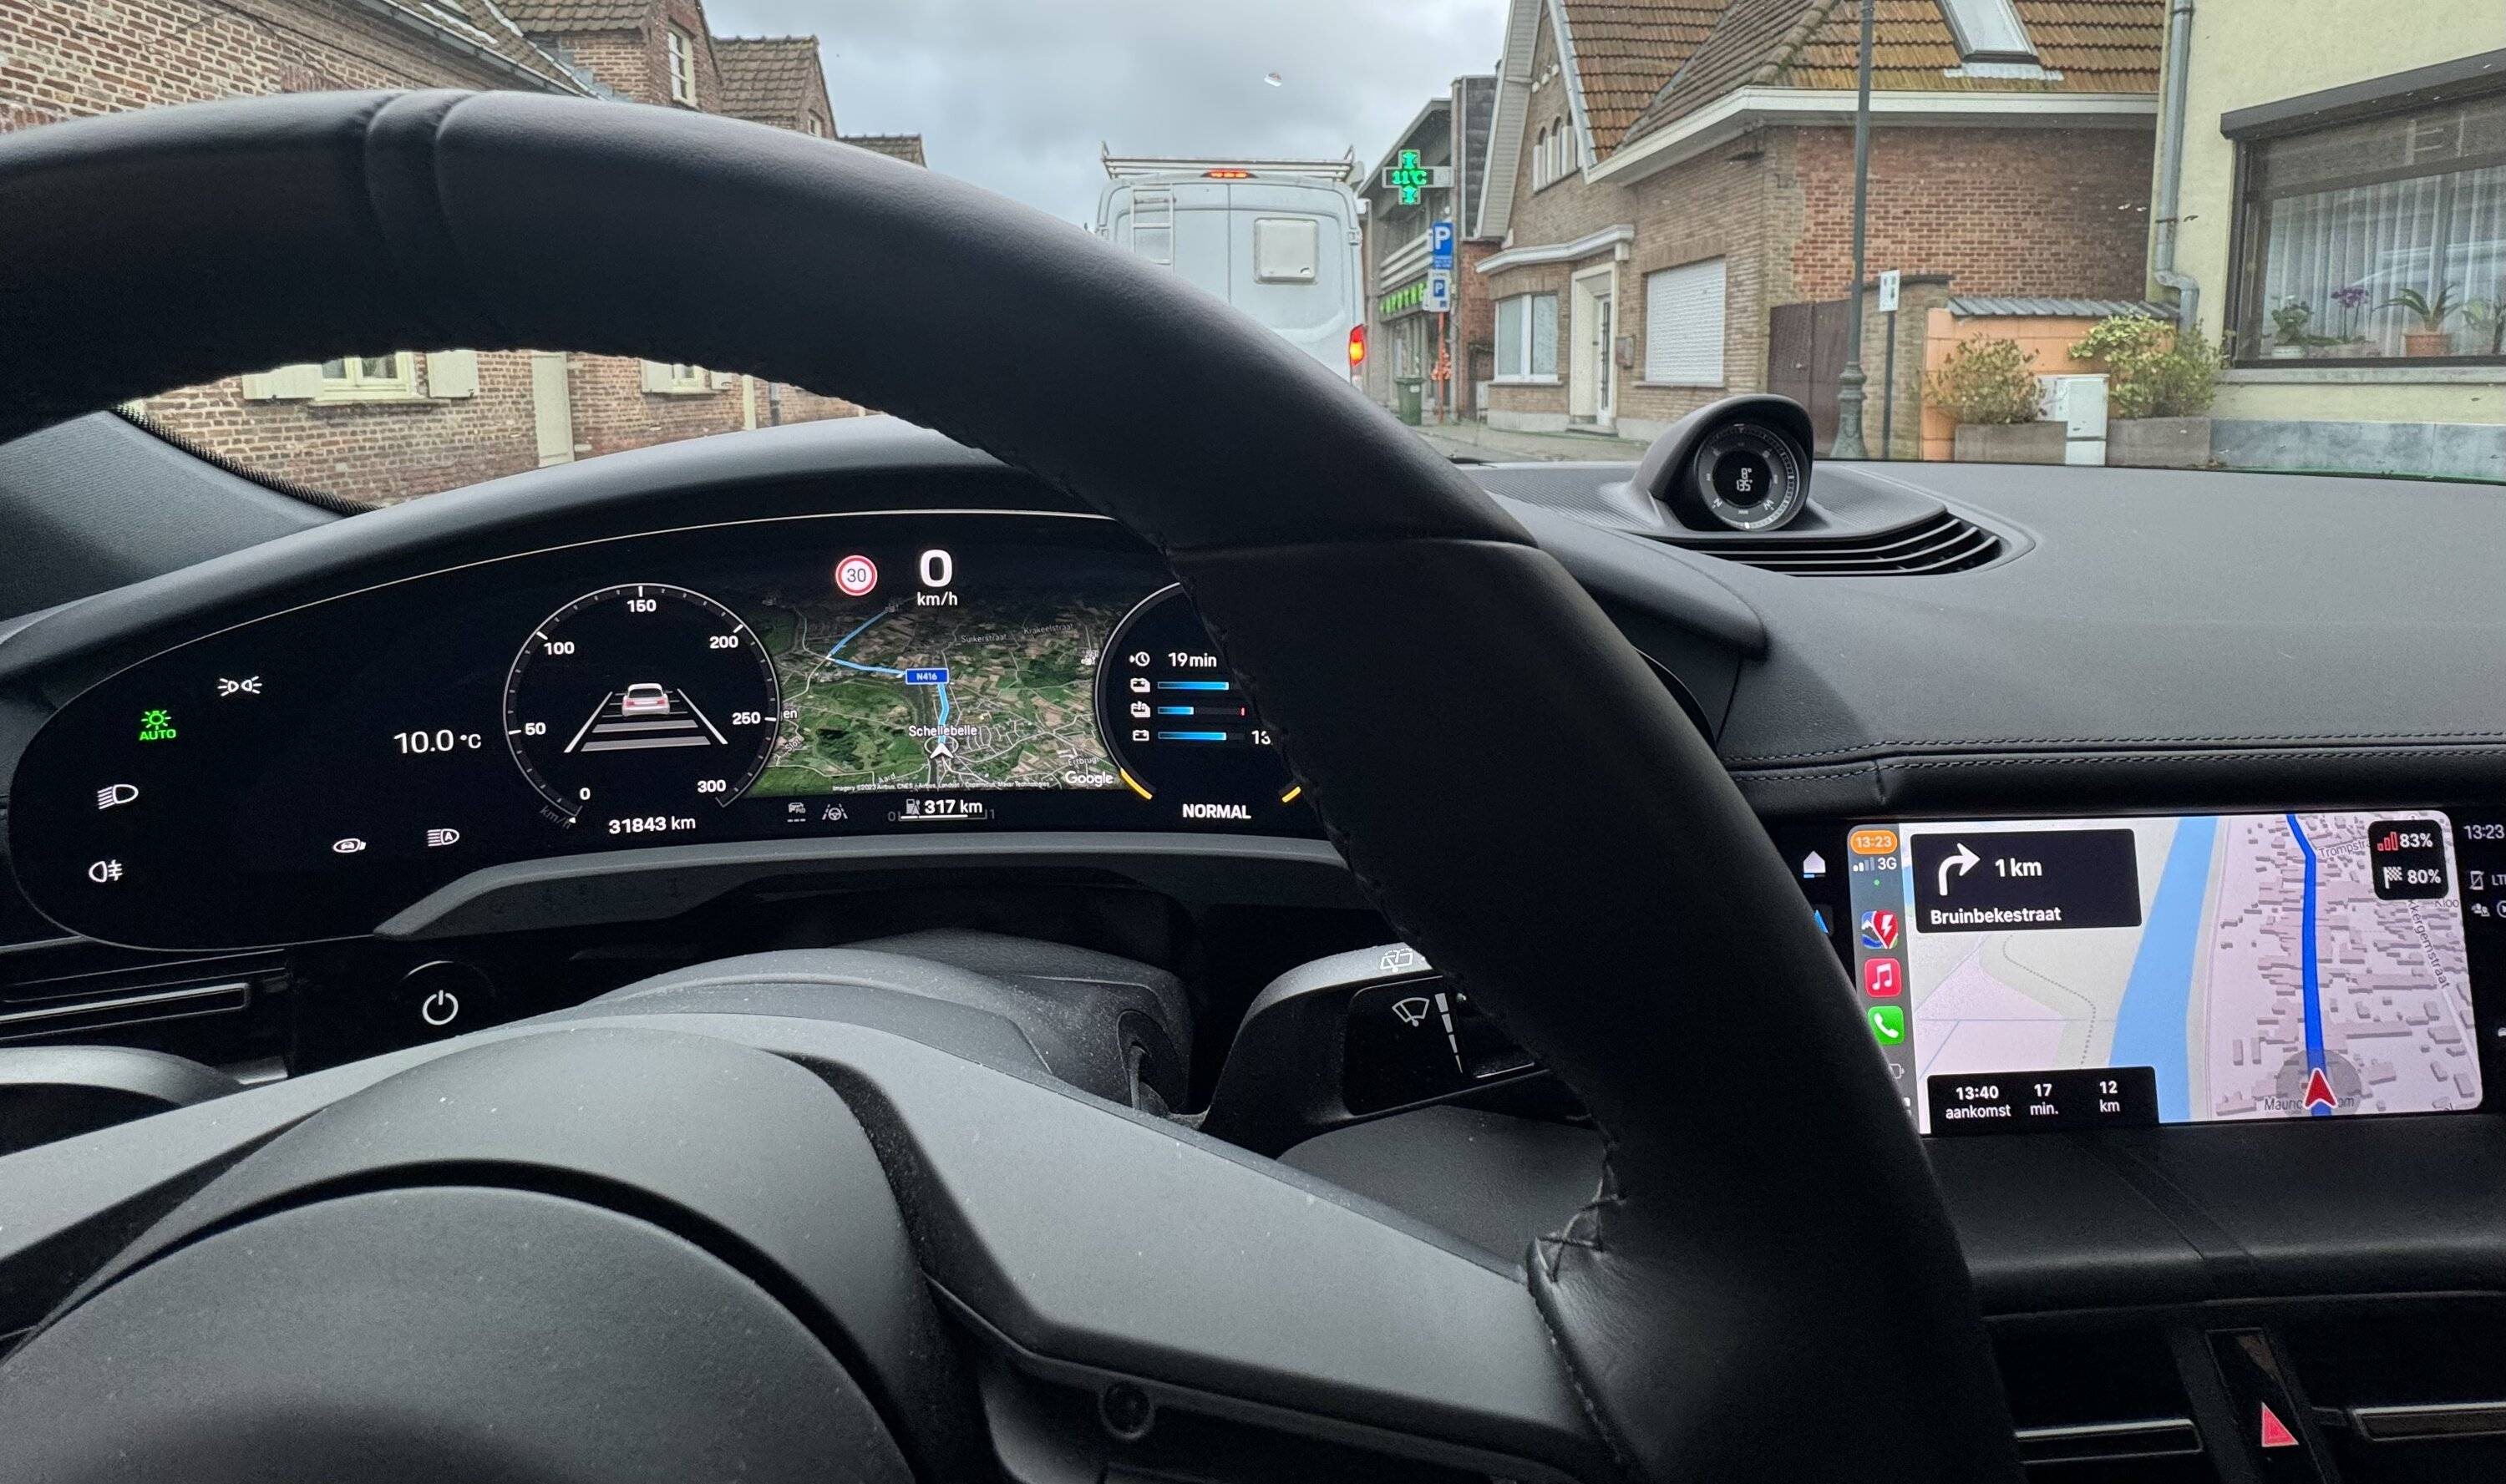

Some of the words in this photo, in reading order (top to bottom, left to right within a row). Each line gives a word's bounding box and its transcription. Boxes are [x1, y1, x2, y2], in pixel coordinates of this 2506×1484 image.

[1434, 225, 1451, 250] P
[1434, 281, 1443, 294] P
[846, 568, 866, 583] 30
[920, 549, 953, 588] 0
[626, 599, 657, 613] 150
[916, 591, 958, 606] km/h
[709, 635, 739, 649] 200
[961, 633, 1007, 643] Suikerstraat
[544, 641, 575, 656] 100
[1168, 651, 1188, 667] 19
[1190, 651, 1217, 667] min
[916, 672, 938, 681] N416
[732, 711, 761, 725] 250
[139, 728, 177, 741] AUTO
[525, 722, 546, 736] 50
[908, 724, 978, 737] Schellebelle
[393, 729, 454, 754] 10.0
[459, 732, 482, 750] °C
[697, 779, 727, 793] 300
[1064, 770, 1114, 788] Google
[580, 787, 591, 801] 0
[925, 799, 956, 814] 317
[960, 799, 983, 813] km
[1182, 803, 1252, 819] NORMAL
[608, 817, 667, 834] 31843
[671, 816, 696, 830] km
[2463, 823, 2505, 840] 13:23
[1856, 835, 1892, 848] 13:23
[2399, 833, 2433, 848] 83%
[1877, 857, 1897, 871] 3G
[1995, 858, 2006, 877] 1
[2010, 858, 2042, 877] km
[2407, 869, 2442, 884] 80%
[1930, 907, 2062, 925] Bruinbekestraat
[1956, 1085, 1999, 1101] 13:40
[2034, 1083, 2052, 1097] 17
[2099, 1080, 2118, 1094] 12
[1945, 1104, 2011, 1120] aankomst
[2030, 1101, 2059, 1116] min.
[2099, 1098, 2120, 1112] km
